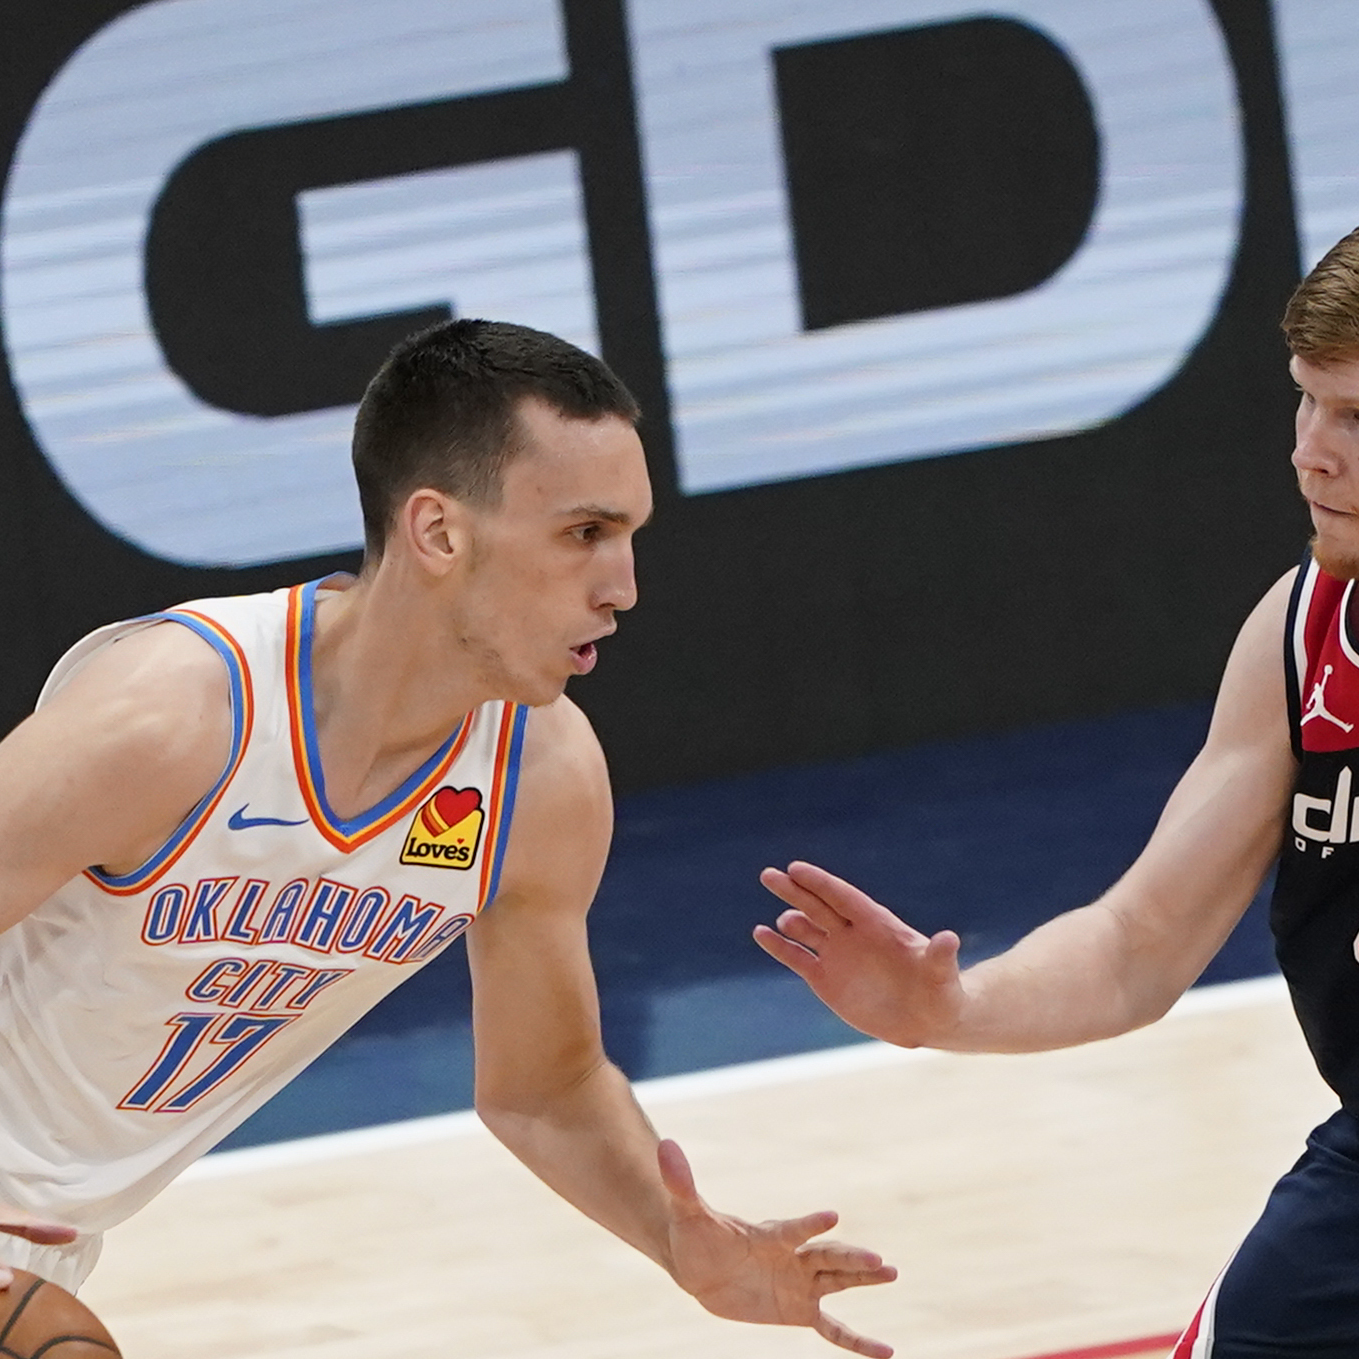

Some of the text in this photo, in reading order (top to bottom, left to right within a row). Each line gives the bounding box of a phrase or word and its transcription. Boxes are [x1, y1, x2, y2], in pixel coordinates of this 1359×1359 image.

[1294, 836, 1335, 859] OF
[141, 876, 476, 966] OKLAHOMA
[185, 957, 354, 1010] CITY
[116, 1012, 303, 1113] 17
